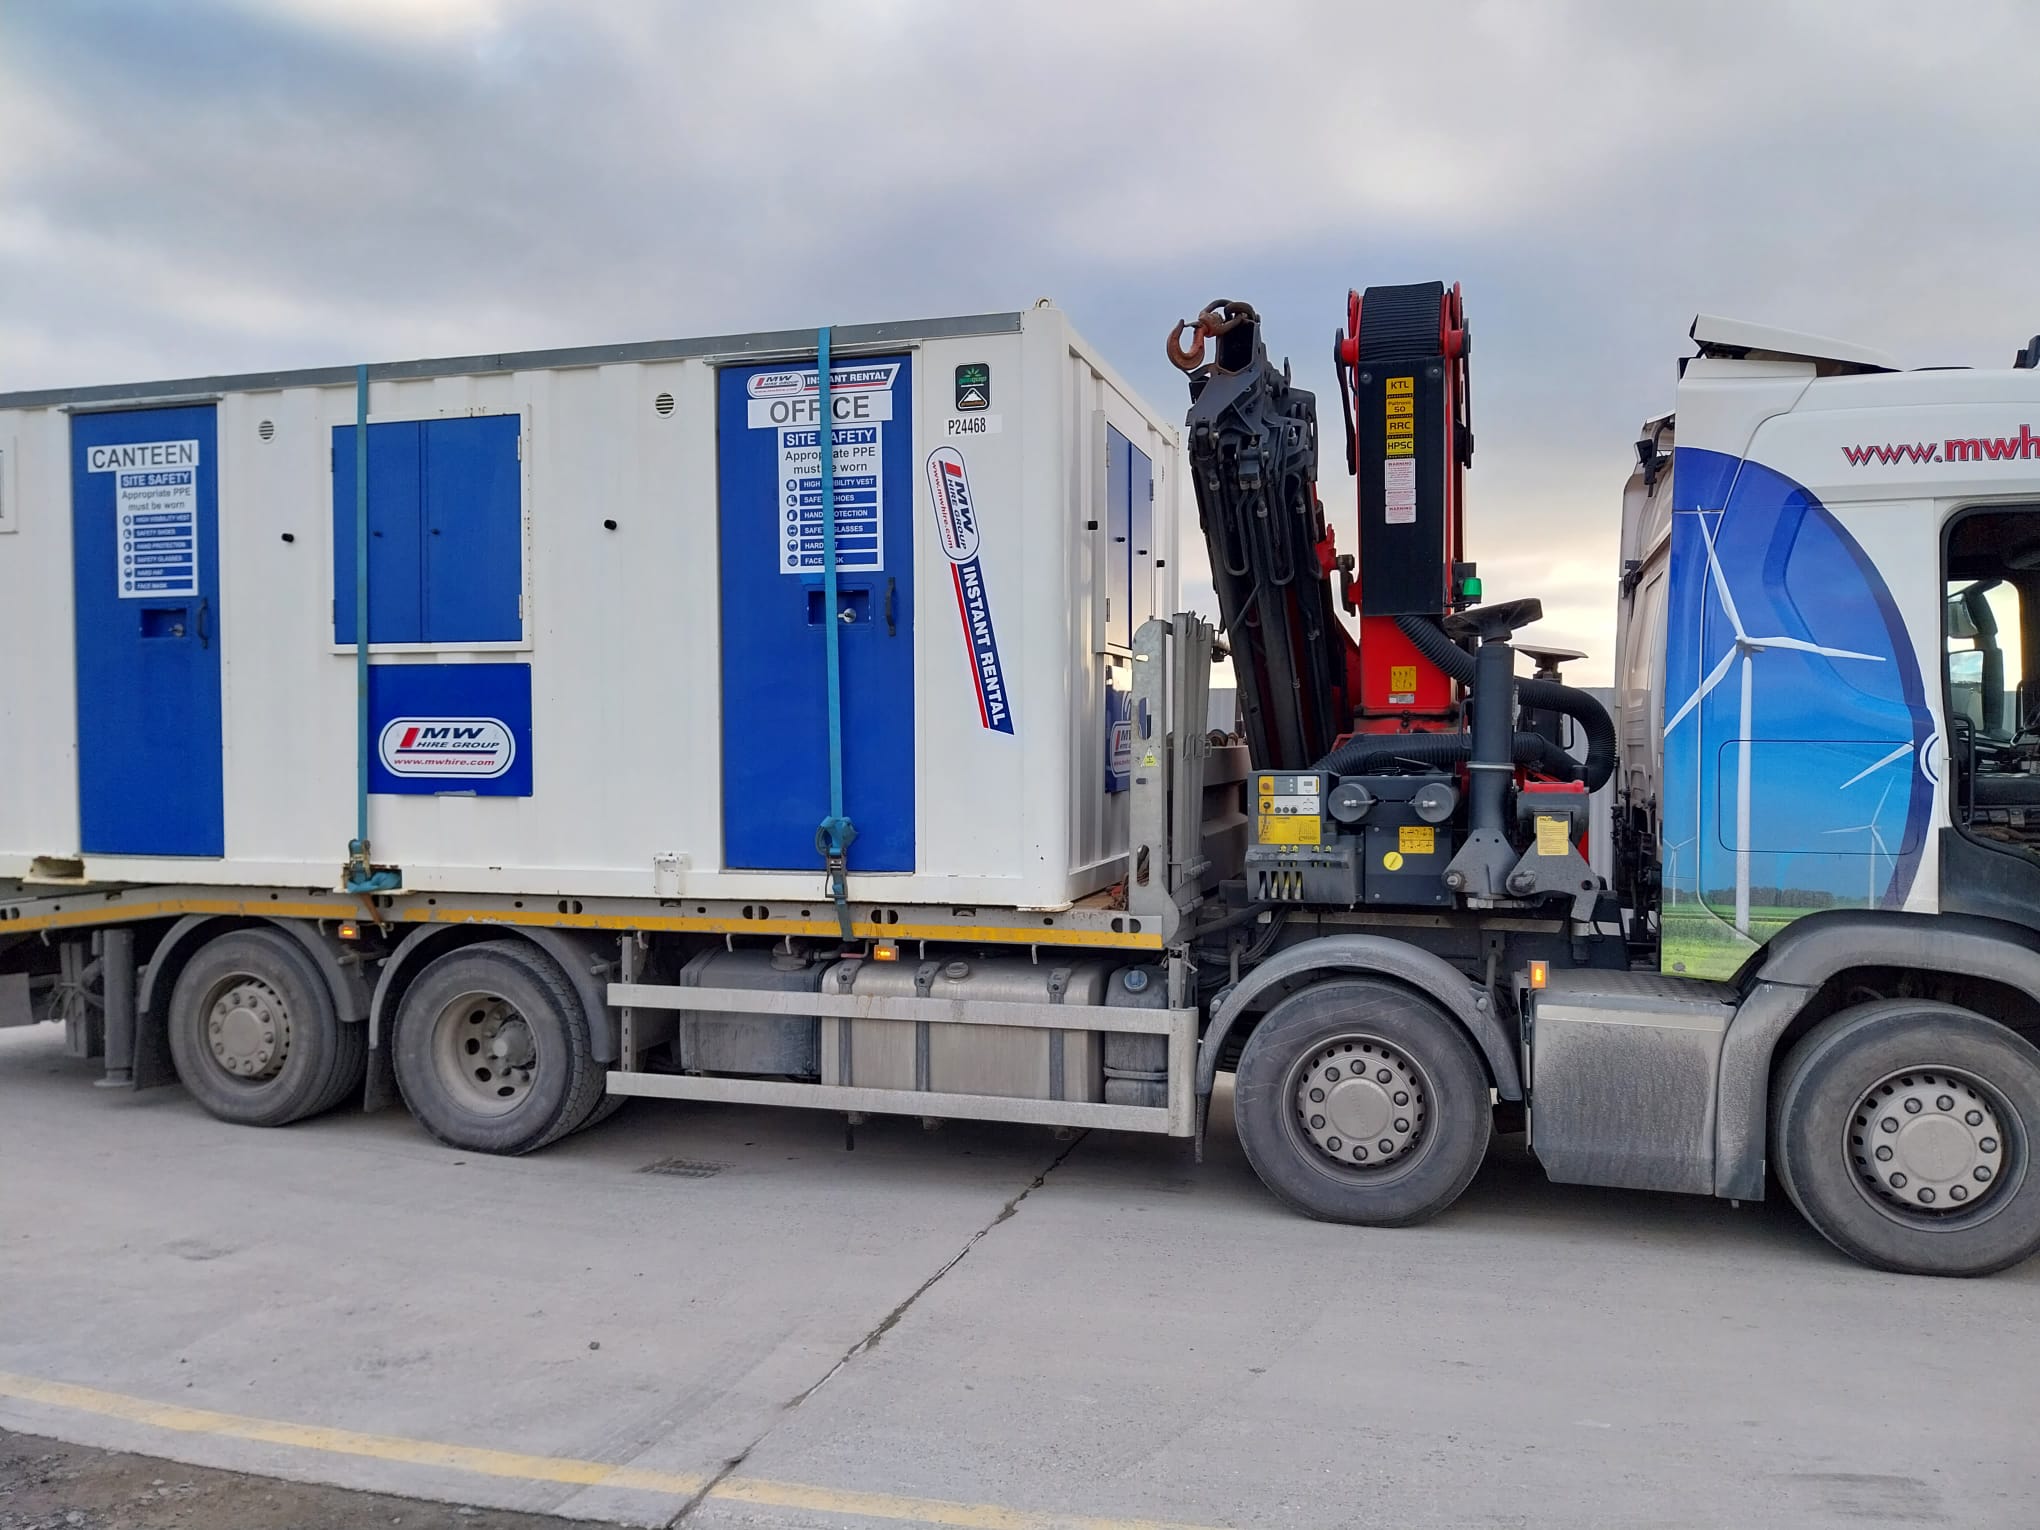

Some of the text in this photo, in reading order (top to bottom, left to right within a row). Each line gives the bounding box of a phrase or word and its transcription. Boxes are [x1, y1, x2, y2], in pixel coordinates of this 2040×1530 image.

[807, 371, 887, 385] INSANT RENTAL
[1391, 381, 1409, 390] KTL
[770, 395, 870, 424] OFFCE
[948, 417, 986, 436] P24468
[1389, 421, 1411, 430] RRC
[786, 430, 873, 446] SITE AFETY
[1388, 441, 1413, 450] HPSC
[92, 443, 193, 469] CANTEEN
[785, 447, 876, 463] Appropate PPE
[793, 465, 821, 474] must
[840, 463, 867, 472] worn
[122, 472, 189, 487] SITE SAFETY
[121, 487, 191, 500] Appropriate PPE
[128, 503, 150, 511] must
[151, 501, 162, 510] be
[931, 461, 953, 549] www.mwhire.com
[955, 481, 975, 535] MW
[947, 478, 967, 550] HIRE GROUP
[804, 526, 824, 534] SAFE
[963, 566, 1006, 726] INSTANT RENTAL
[421, 727, 485, 739] MW
[394, 758, 495, 766] www.mwhire.com
